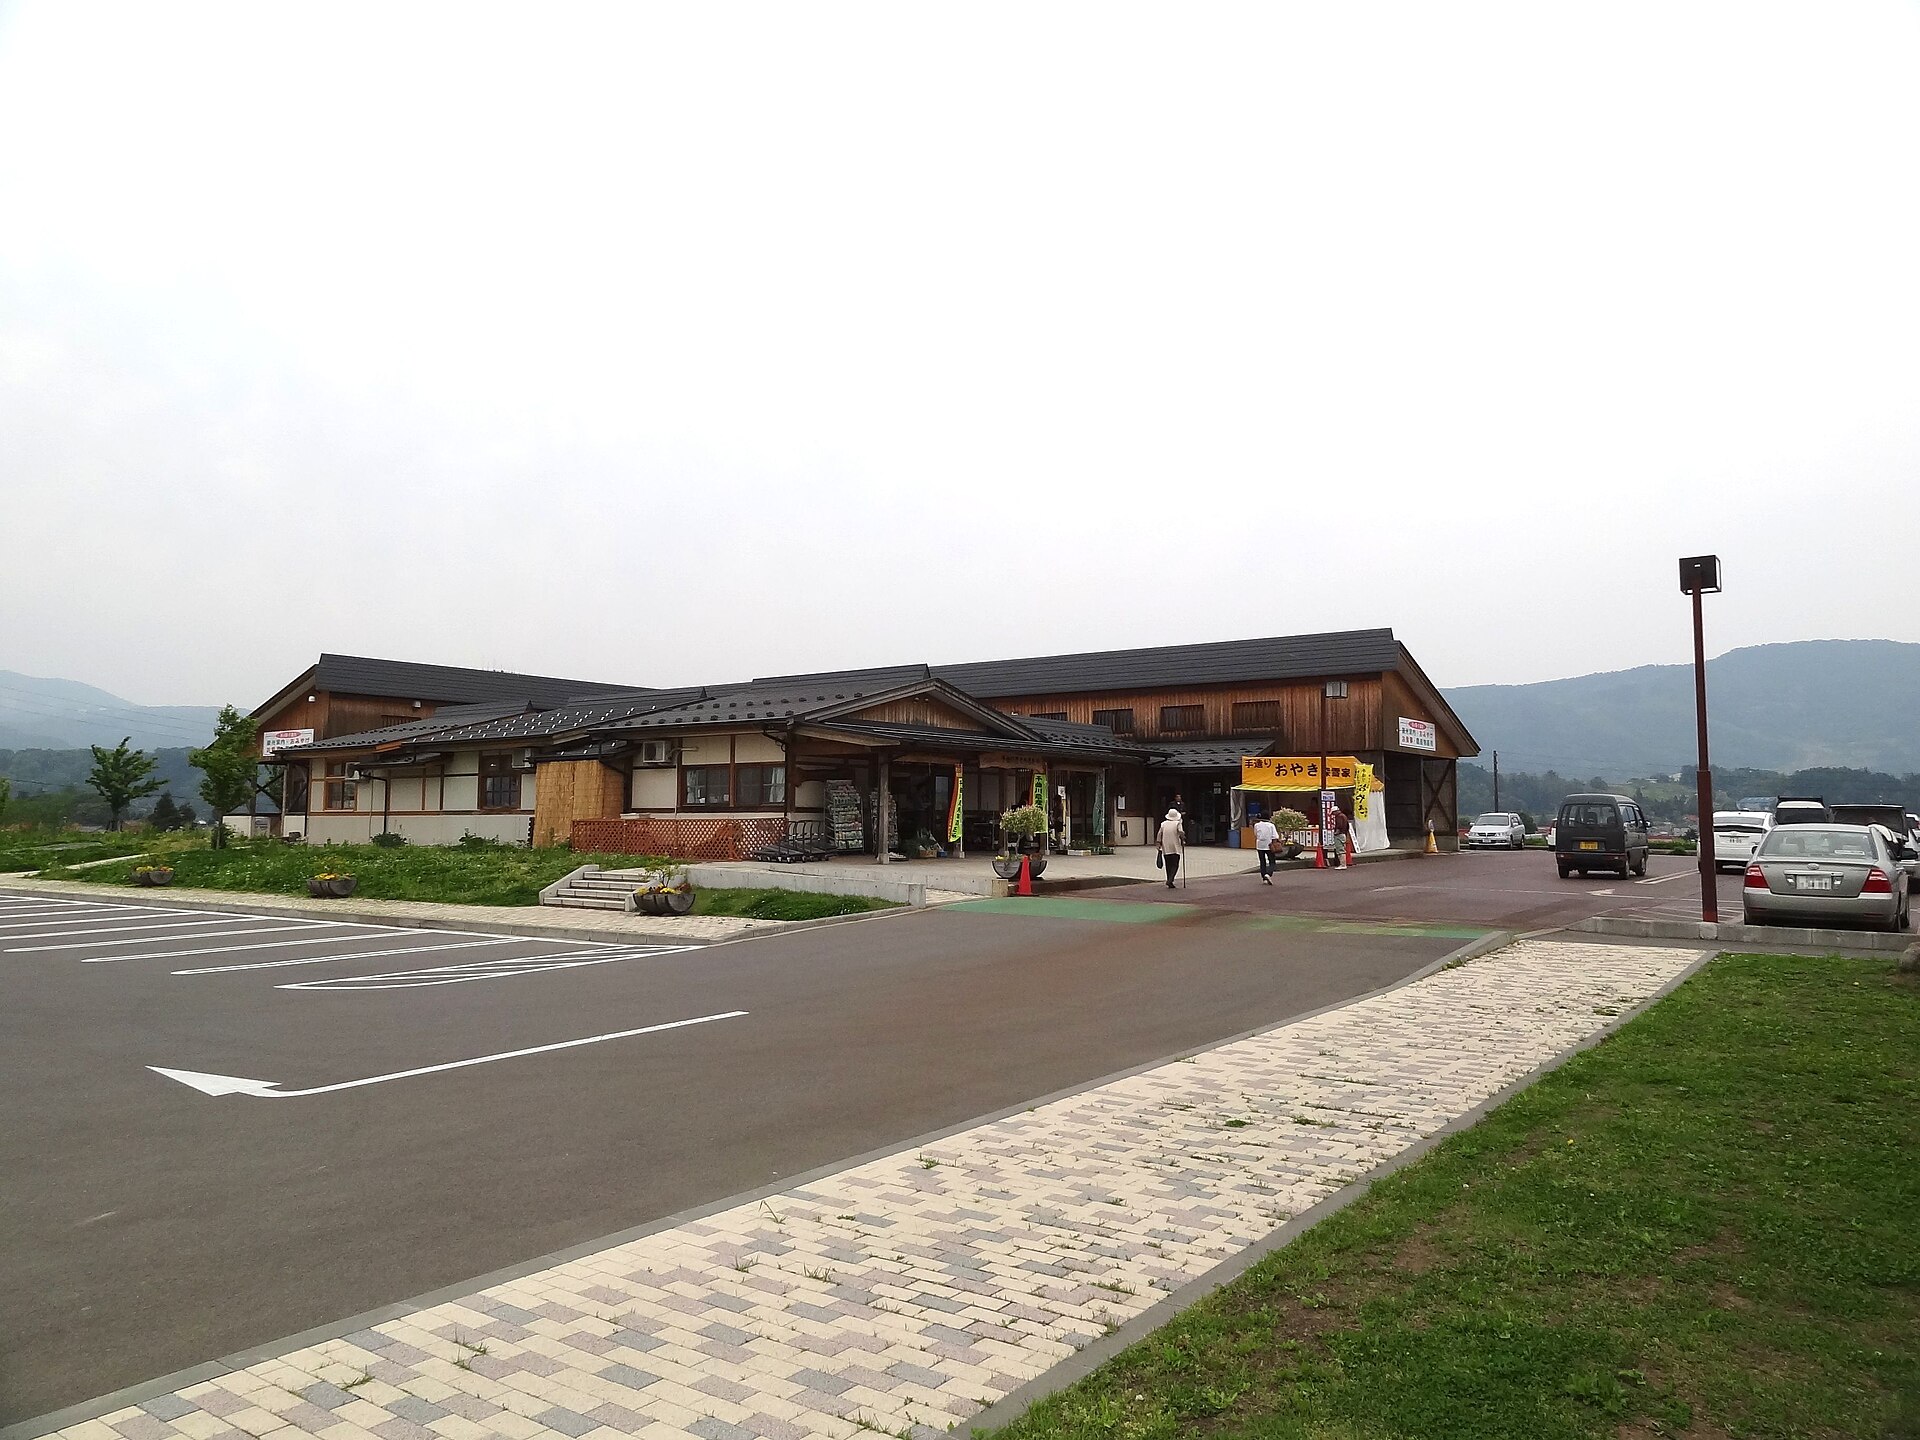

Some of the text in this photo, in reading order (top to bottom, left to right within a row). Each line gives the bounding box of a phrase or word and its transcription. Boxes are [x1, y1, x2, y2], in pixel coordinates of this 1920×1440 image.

[1244, 758, 1272, 769] 手造り
[1274, 763, 1319, 777] おやき
